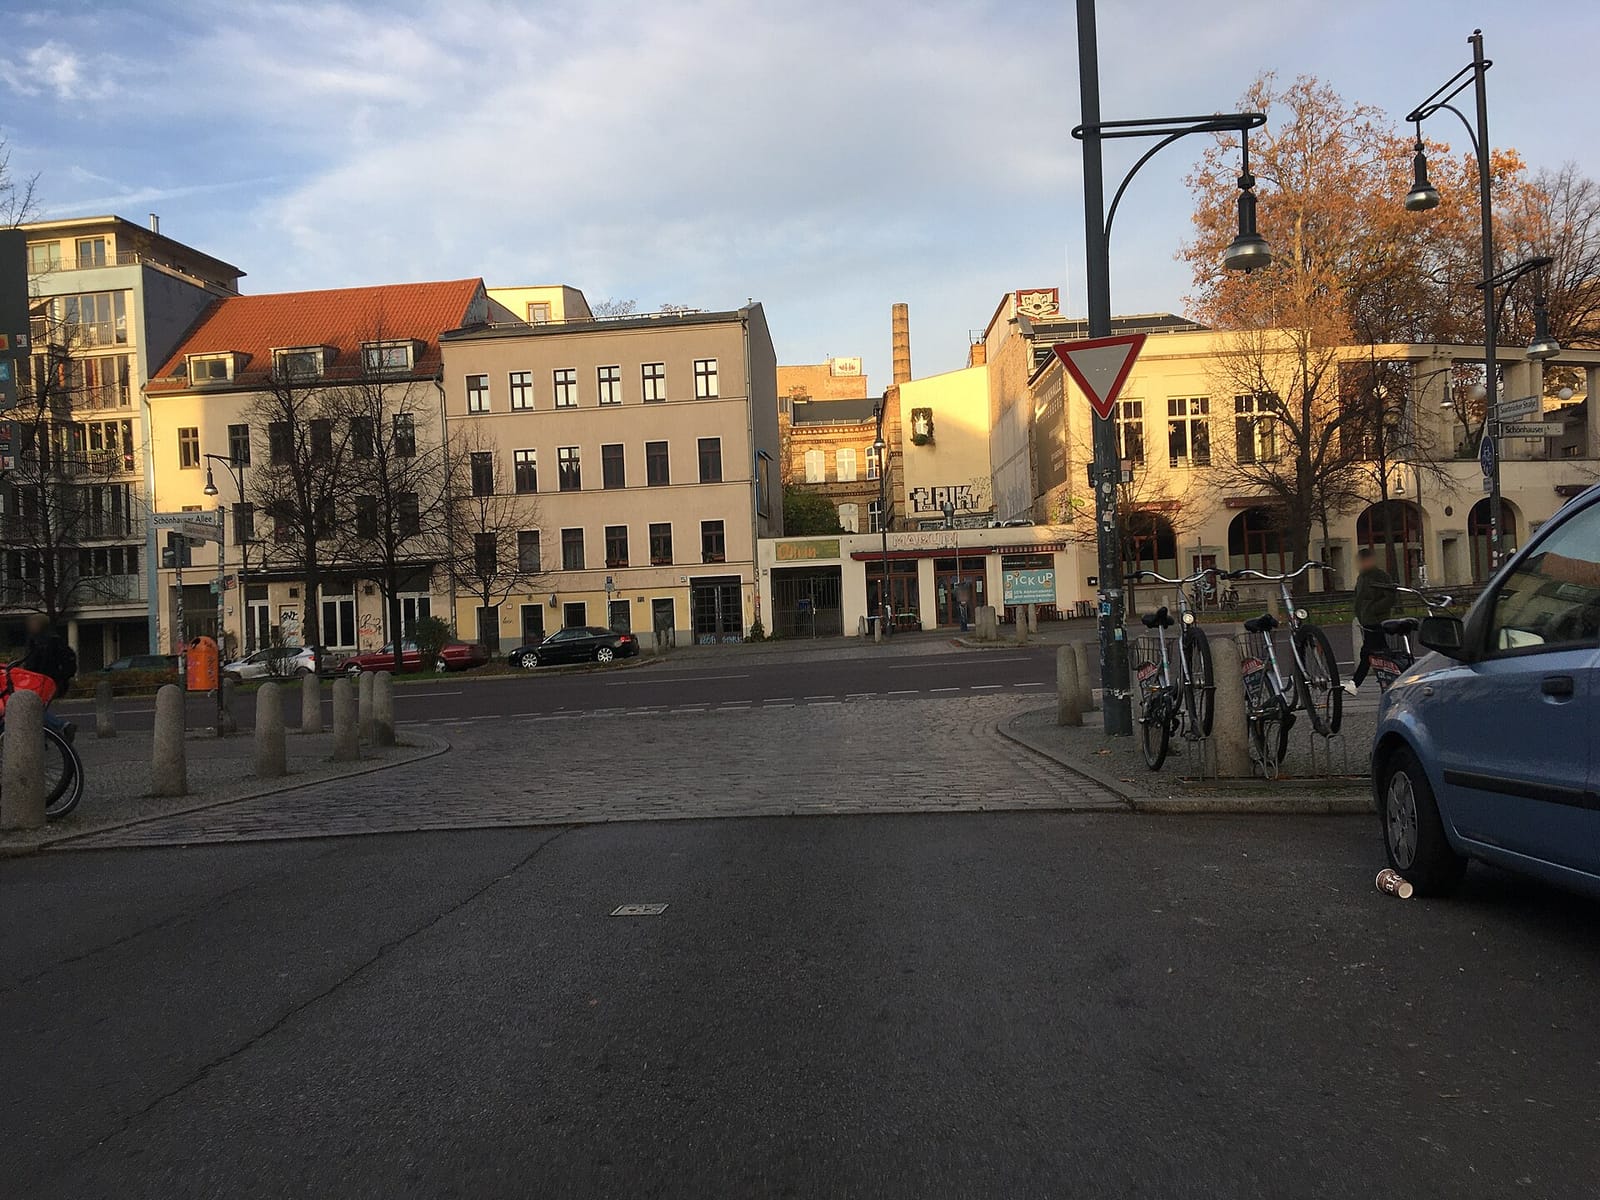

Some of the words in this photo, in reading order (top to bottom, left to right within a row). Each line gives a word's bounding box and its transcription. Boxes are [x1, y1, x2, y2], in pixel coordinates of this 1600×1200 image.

[196, 515, 212, 523] Allee
[1006, 574, 1036, 586] PICK
[1037, 572, 1053, 584] UP
